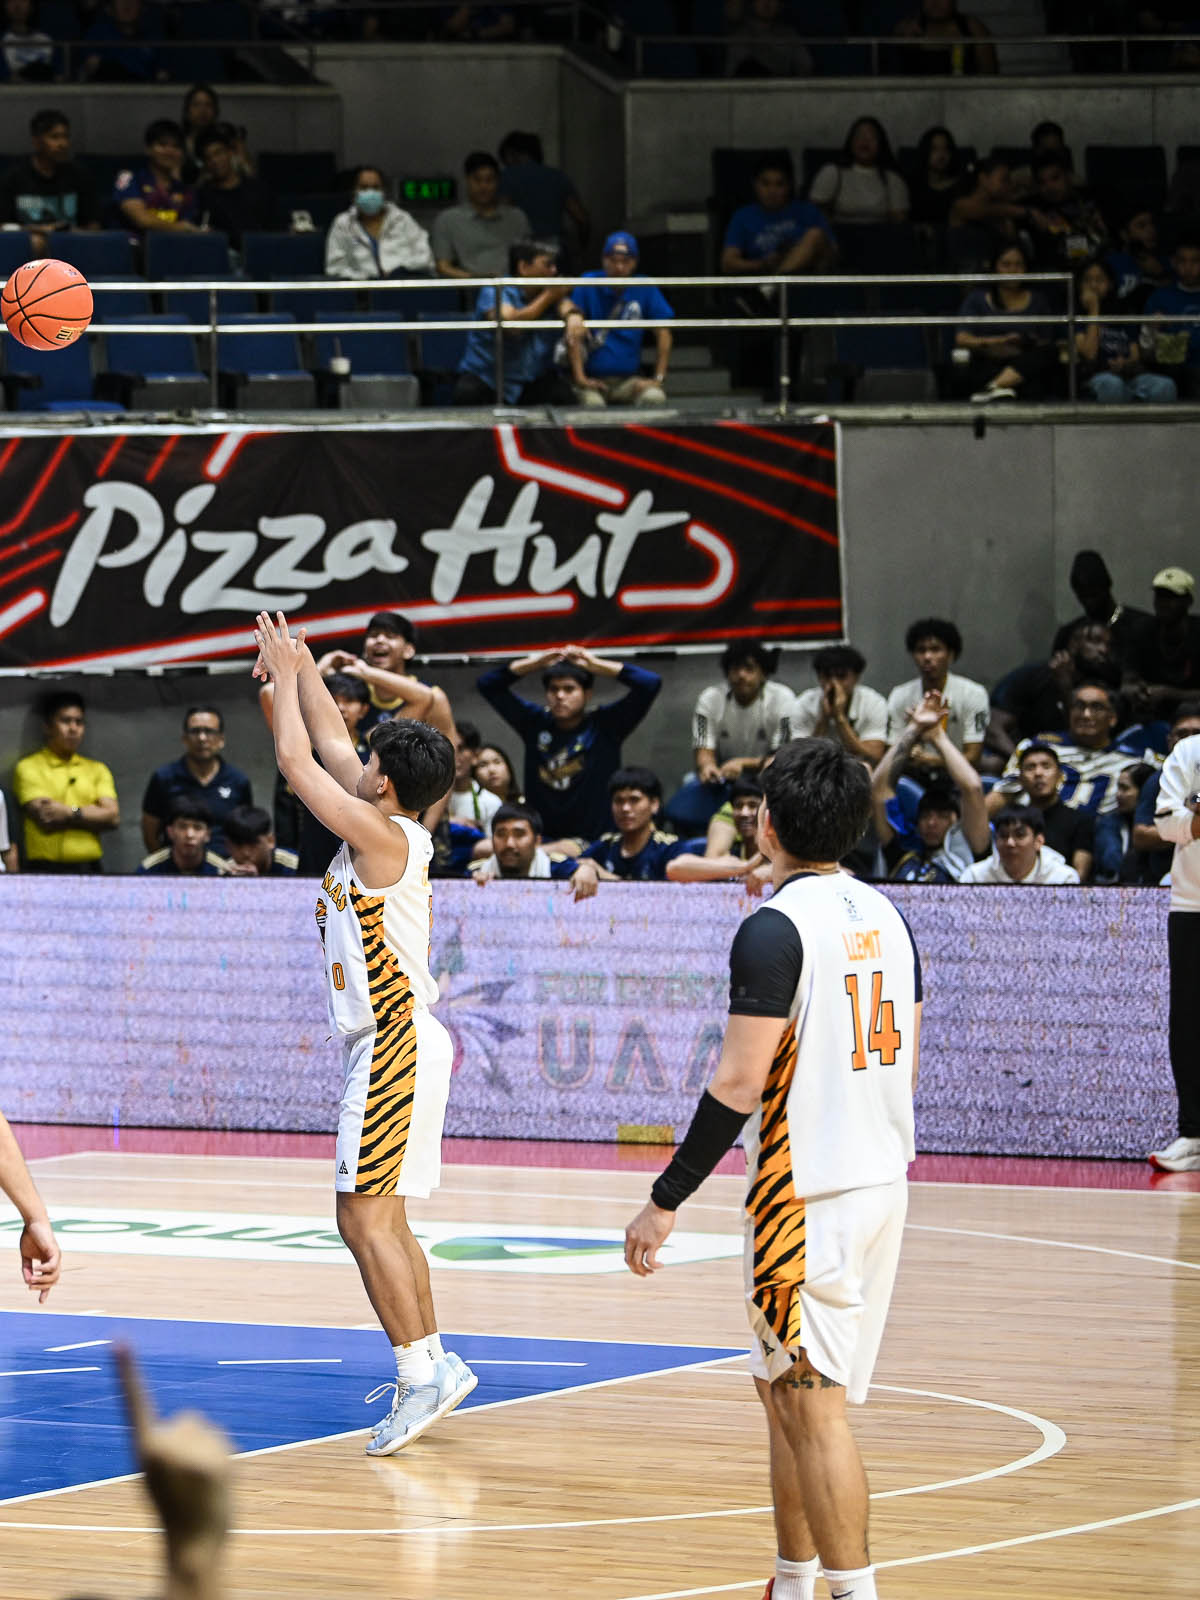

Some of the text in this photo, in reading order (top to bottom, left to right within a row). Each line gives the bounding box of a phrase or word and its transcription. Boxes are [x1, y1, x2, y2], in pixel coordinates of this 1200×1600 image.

[50, 475, 690, 627] Pizza Hut
[844, 970, 900, 1071] 14
